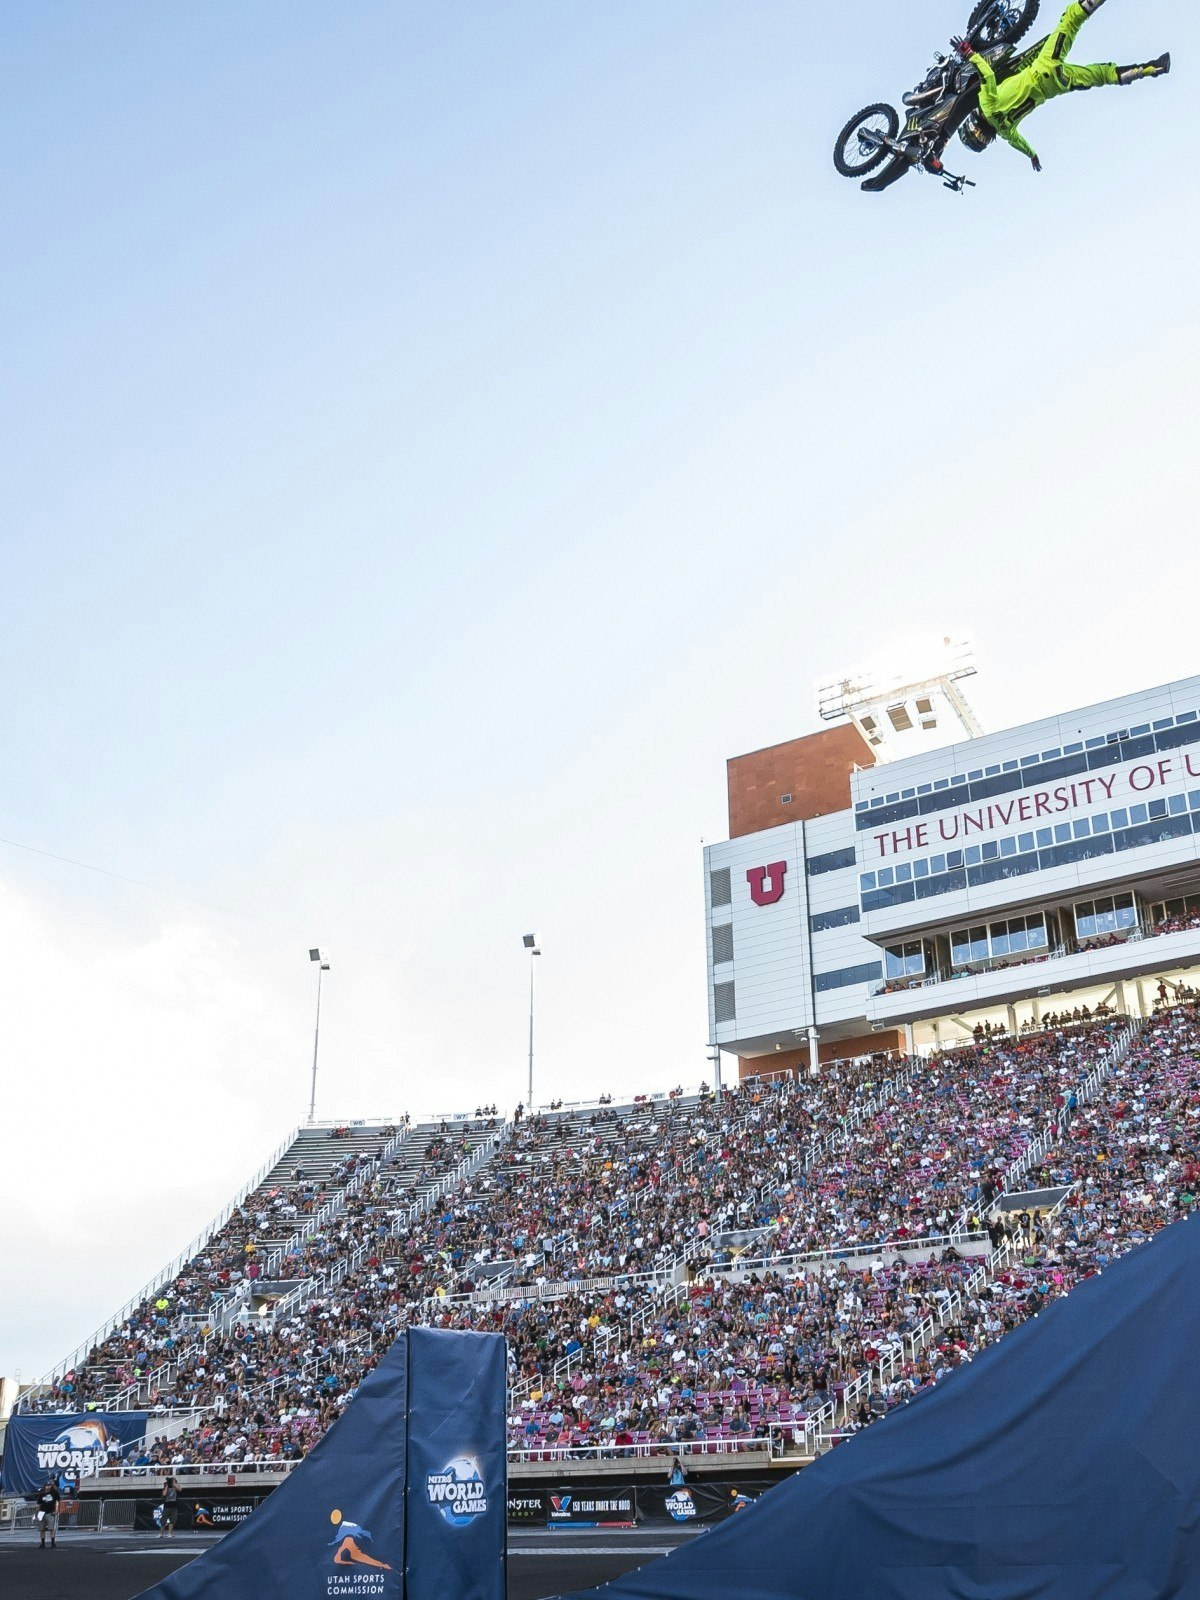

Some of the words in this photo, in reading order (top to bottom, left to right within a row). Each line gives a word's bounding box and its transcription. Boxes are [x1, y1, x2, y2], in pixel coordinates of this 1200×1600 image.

[873, 822, 930, 857] THE
[938, 773, 1118, 841] UNIVERSITY
[1128, 758, 1173, 792] OF
[746, 860, 788, 906] U
[37, 1443, 66, 1452] NITRO
[428, 1472, 452, 1484] NITRO
[427, 1482, 484, 1502] WORLD
[230, 1505, 253, 1513] SPORTS
[452, 1499, 487, 1514] GAMES
[507, 1498, 542, 1510] NSTER
[581, 1501, 595, 1511] YEARS
[665, 1502, 694, 1510] WORLD
[327, 1575, 351, 1585] UTAH
[353, 1574, 385, 1583] SPORTS
[327, 1585, 385, 1595] COMMISSION
